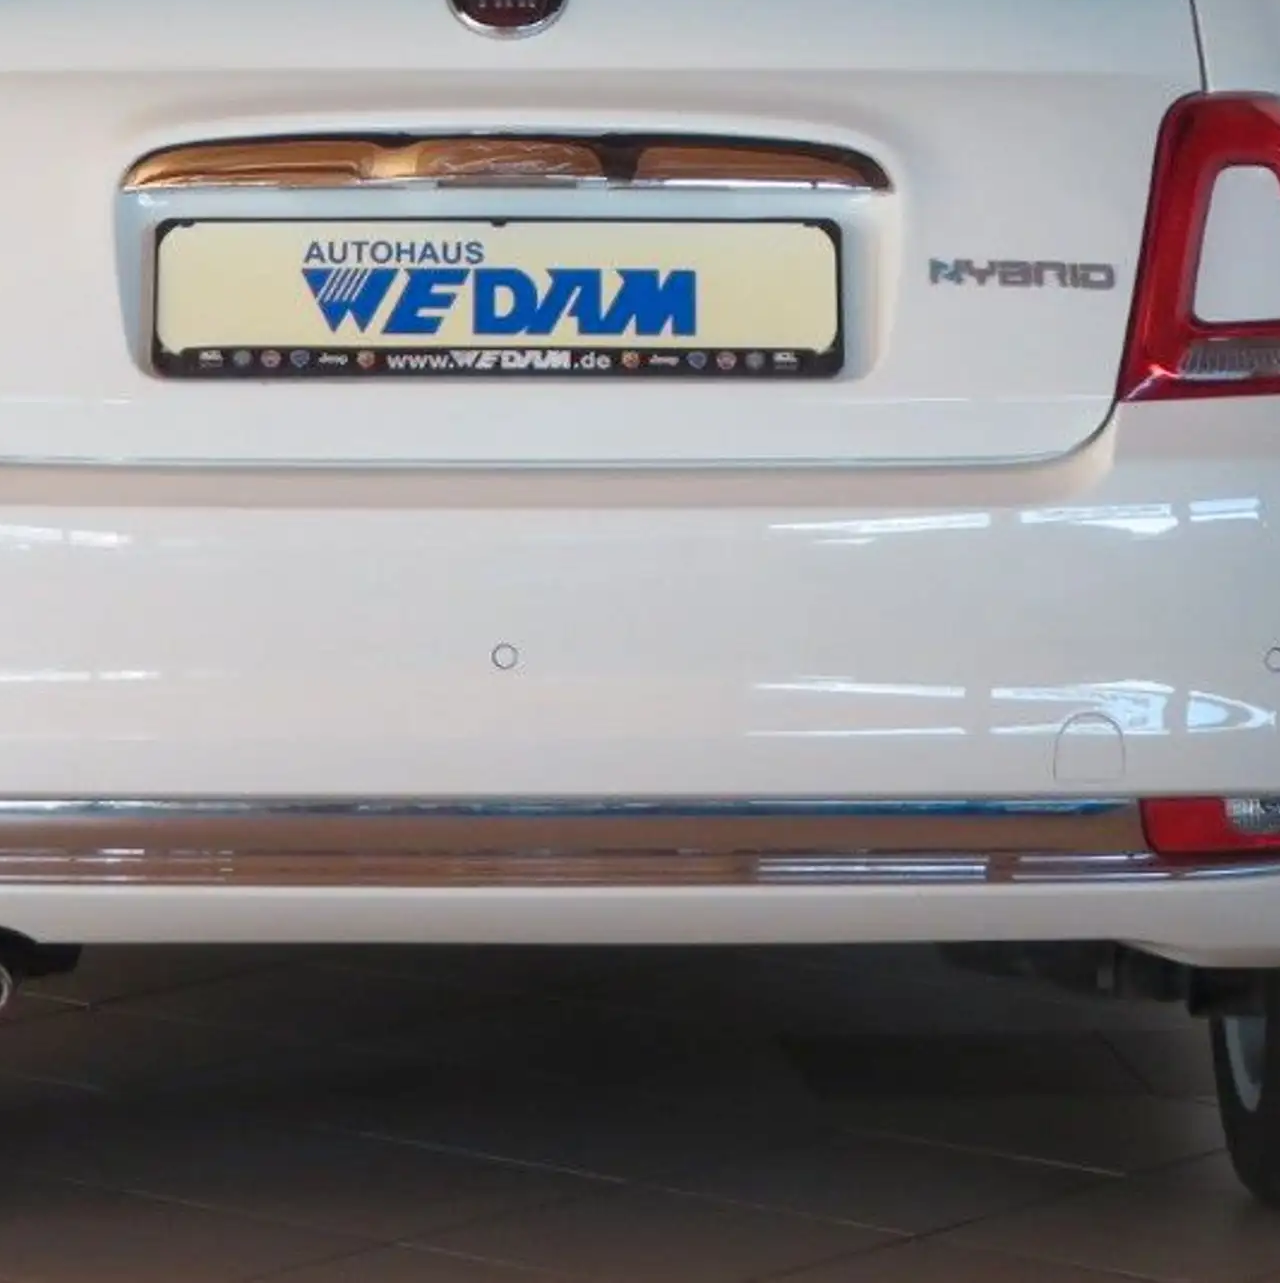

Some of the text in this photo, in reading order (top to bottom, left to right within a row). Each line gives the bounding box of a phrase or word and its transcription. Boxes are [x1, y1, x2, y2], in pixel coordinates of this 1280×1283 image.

[304, 241, 485, 264] AUTOHAUS
[301, 268, 696, 336] WEDAM
[387, 349, 610, 370] www.WEDAM.de
